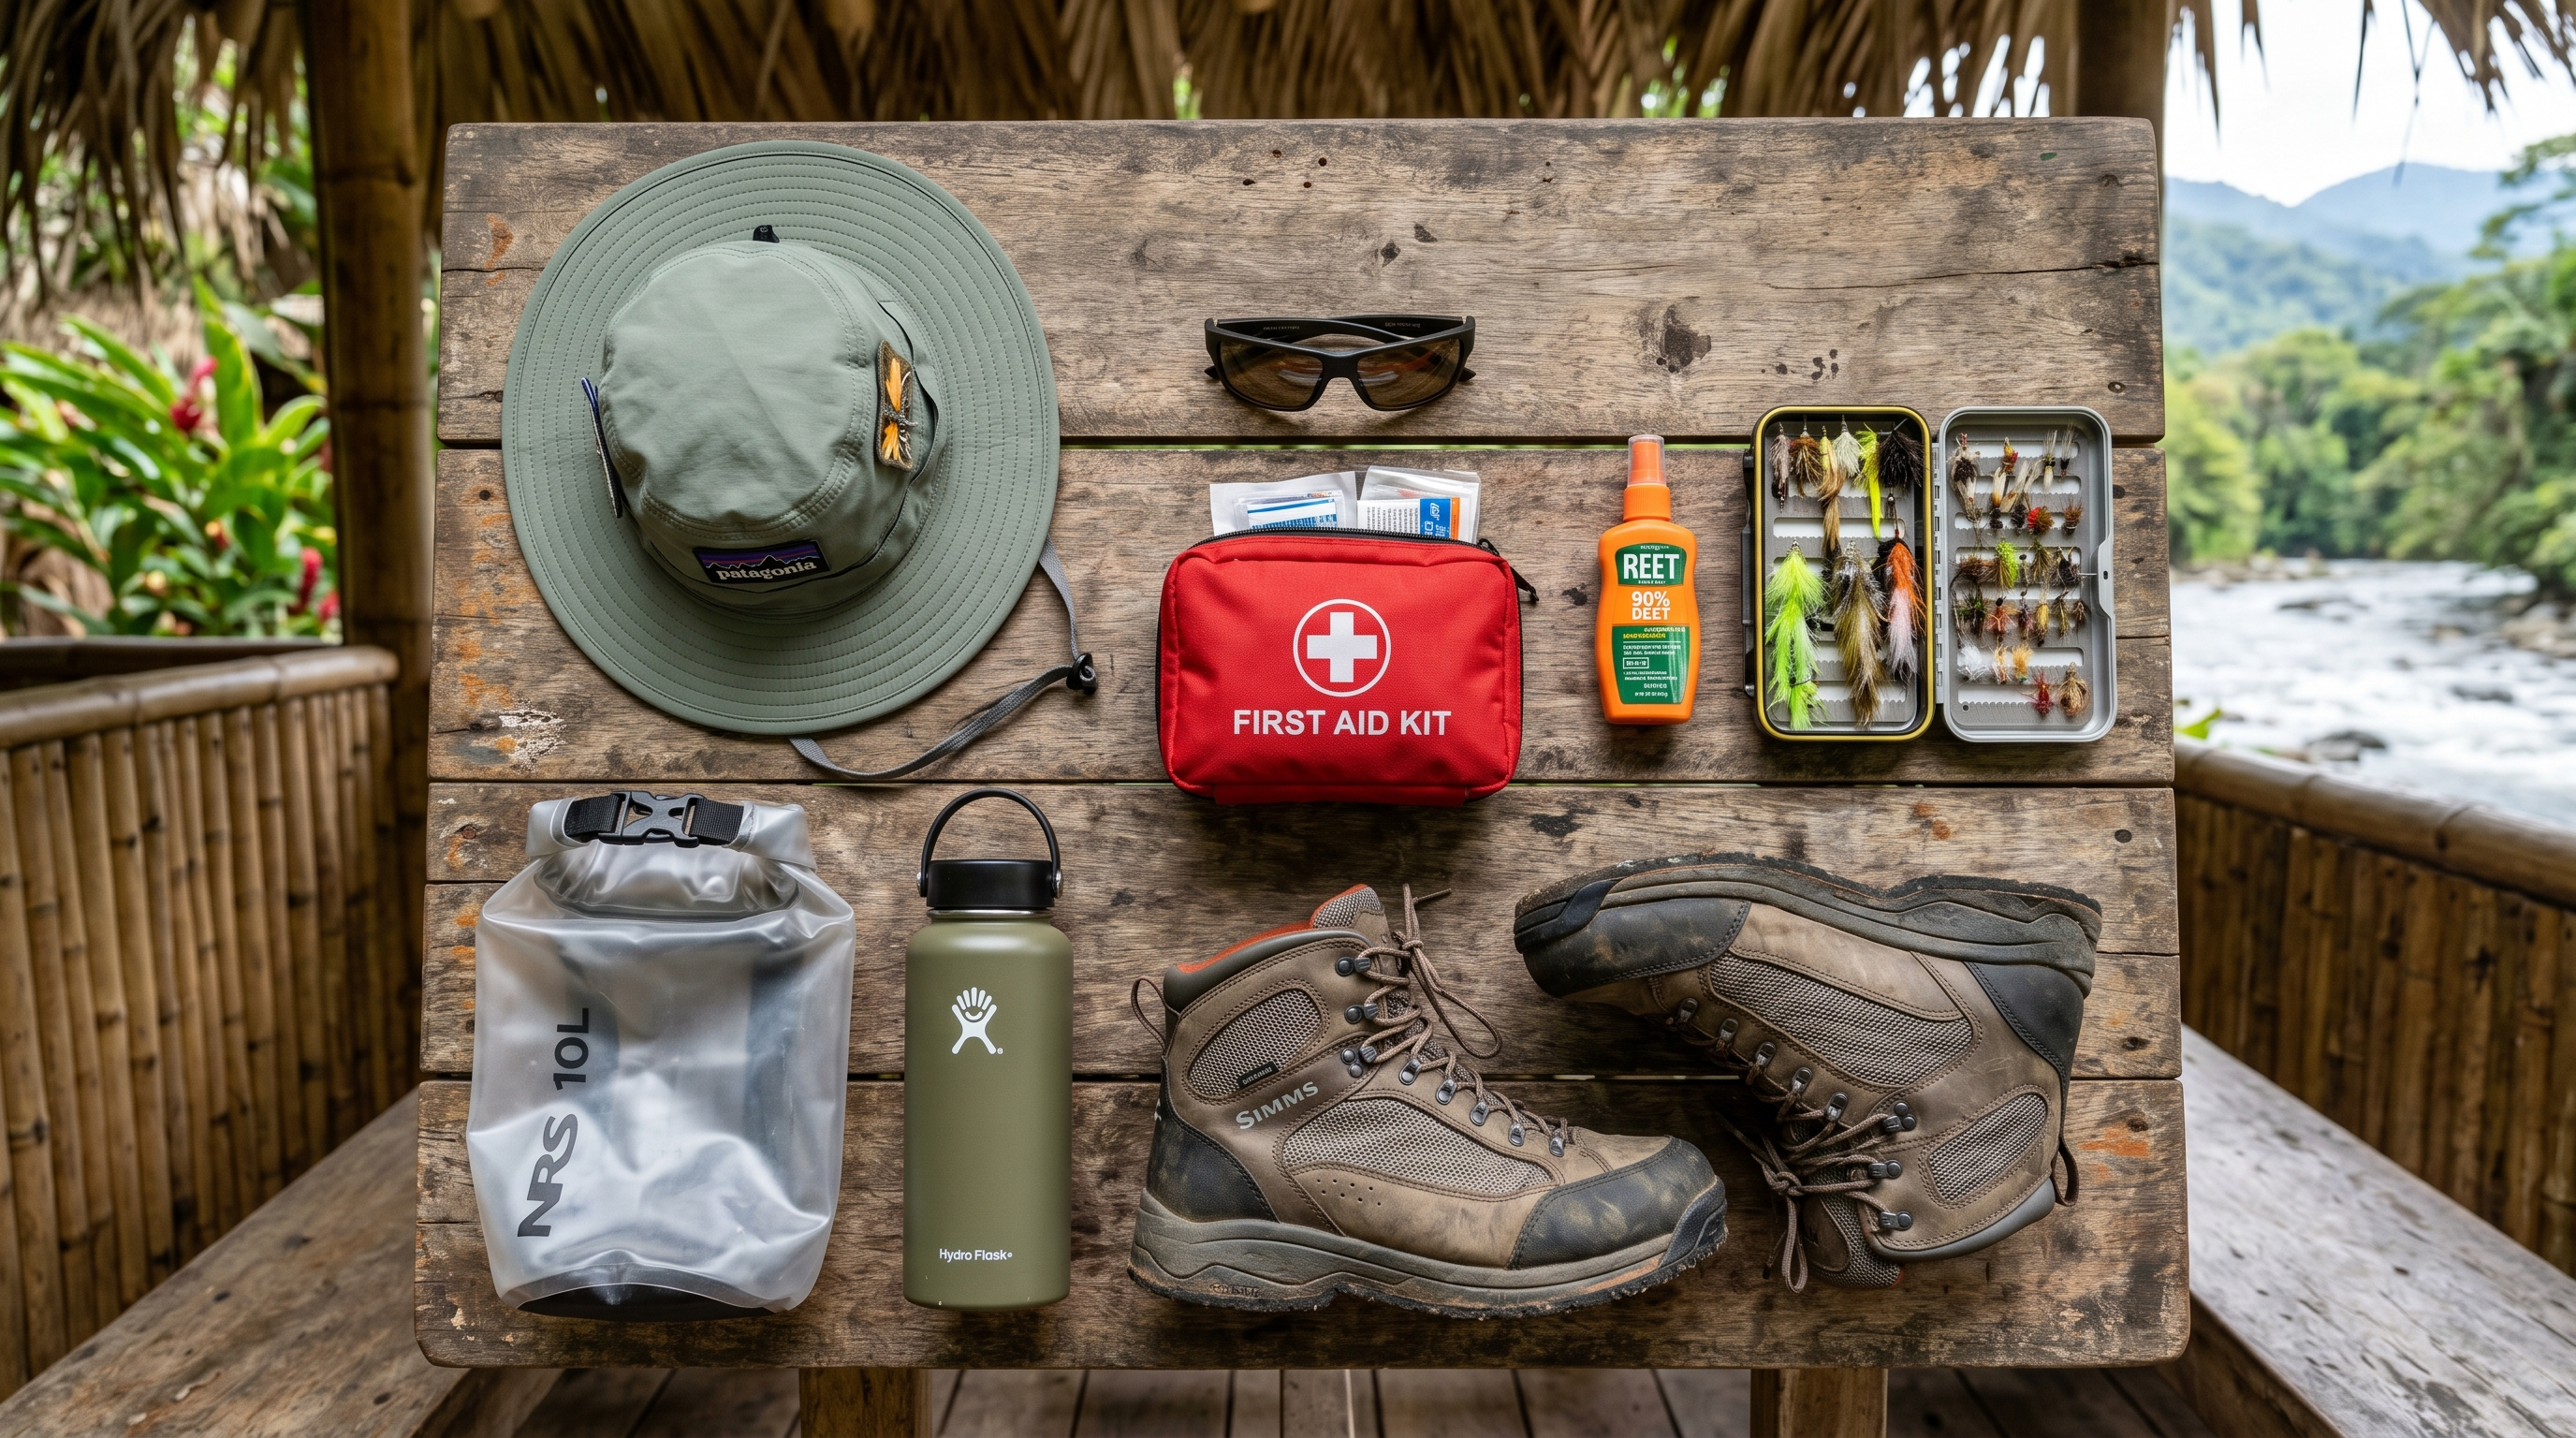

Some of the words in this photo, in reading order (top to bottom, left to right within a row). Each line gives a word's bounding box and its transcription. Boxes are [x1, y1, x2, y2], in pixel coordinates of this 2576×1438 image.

[715, 561, 817, 580] patagonia
[1623, 553, 1680, 580] REET
[1632, 591, 1671, 608] 90%
[1632, 608, 1671, 621] DEET
[1233, 709, 1326, 736] FIRST
[1332, 710, 1390, 736] AID
[1400, 710, 1452, 736] KIT
[552, 1007, 590, 1091] 10L
[1235, 1080, 1320, 1130] SIMMS
[517, 1113, 578, 1238] NRS
[939, 1248, 973, 1263] Hydro
